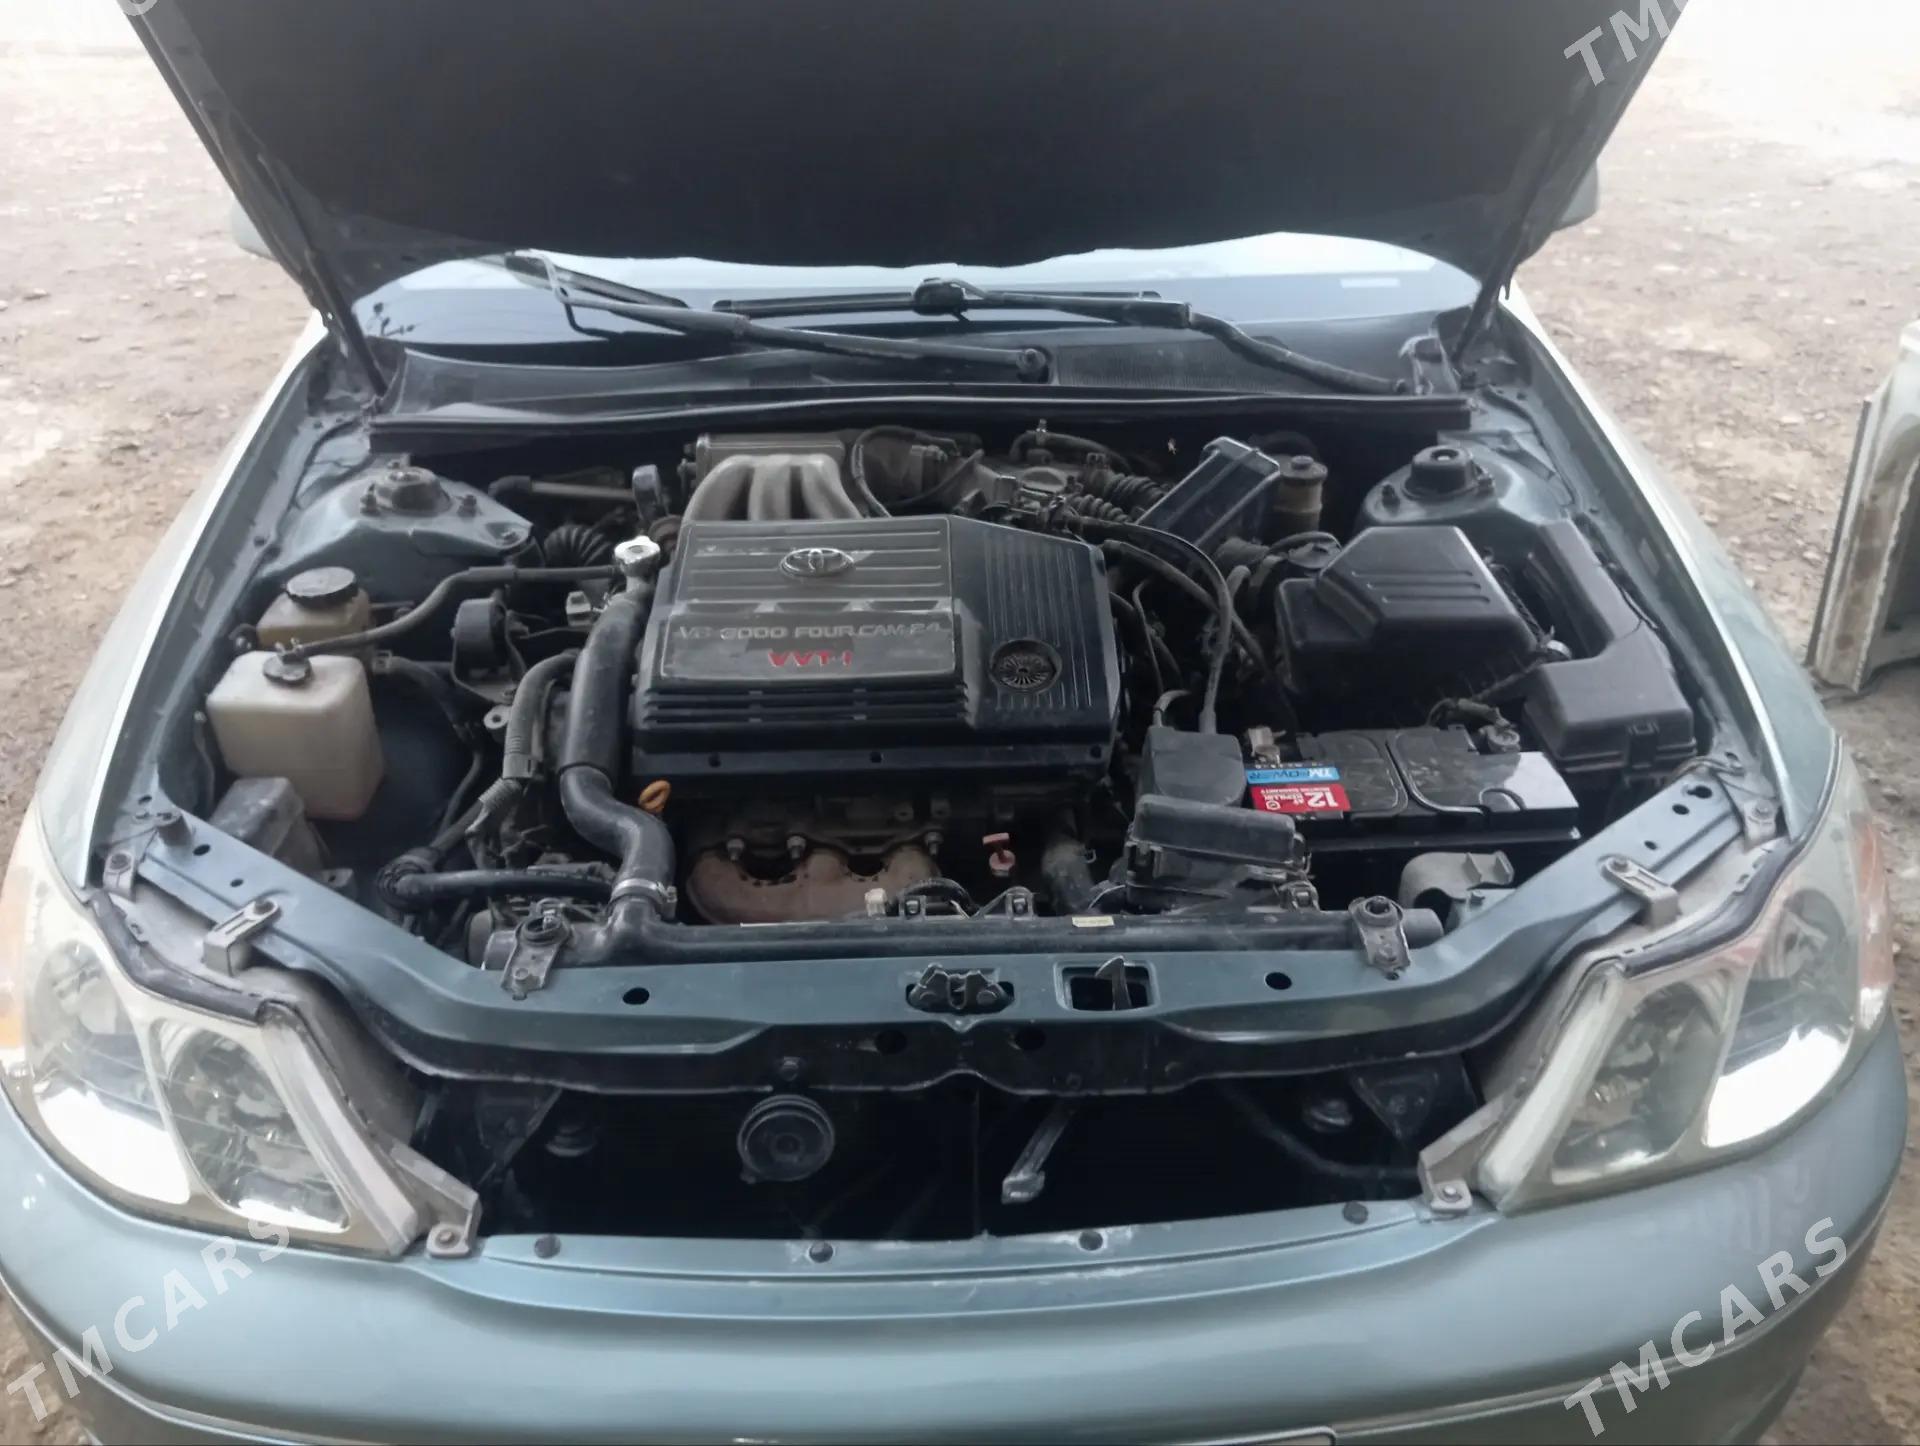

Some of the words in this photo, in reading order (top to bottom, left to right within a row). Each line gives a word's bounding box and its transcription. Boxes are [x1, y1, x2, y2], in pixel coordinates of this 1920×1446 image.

[720, 625, 789, 641] 3000
[793, 624, 855, 639] FOUR
[857, 623, 906, 638] CAM
[1303, 791, 1339, 808] 12
